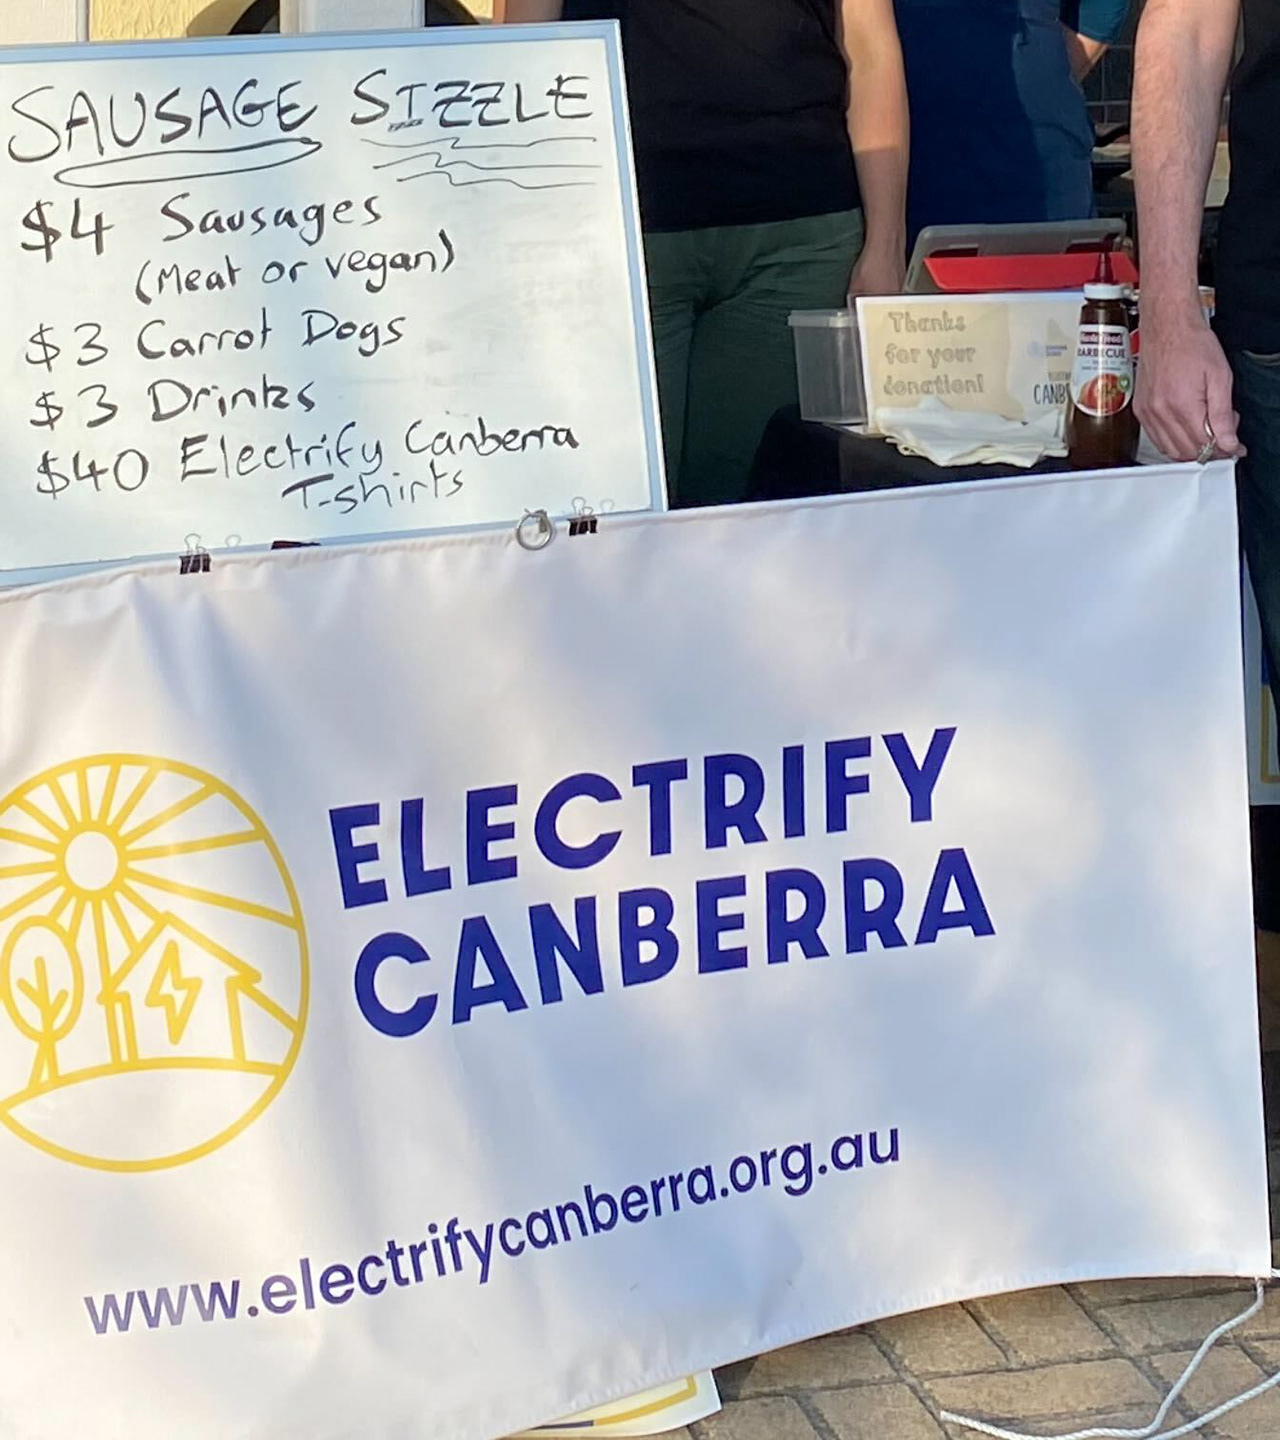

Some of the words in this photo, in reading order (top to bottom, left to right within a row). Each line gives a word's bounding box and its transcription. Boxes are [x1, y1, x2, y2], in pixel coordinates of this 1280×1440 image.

[7, 76, 318, 163] SAUSAGE
[350, 68, 594, 132] SIZZLE
[20, 200, 114, 263] $4
[161, 193, 383, 242] Sausages
[261, 259, 308, 285] or
[326, 228, 457, 292] vegan)
[137, 307, 274, 361] Carrot
[302, 309, 407, 358] Dogs
[887, 309, 967, 333] Thanks
[884, 342, 922, 365] for
[926, 346, 977, 370] your
[147, 377, 317, 423] Drinks
[1033, 383, 1070, 405] CANB
[35, 448, 150, 499] $40
[179, 421, 384, 482] Electrify
[405, 416, 580, 457] Canberra
[327, 726, 958, 910] ELECTRIFY
[353, 846, 996, 1039] CANBERRA
[84, 1124, 903, 1336] www.electrifycanberra.org.au
